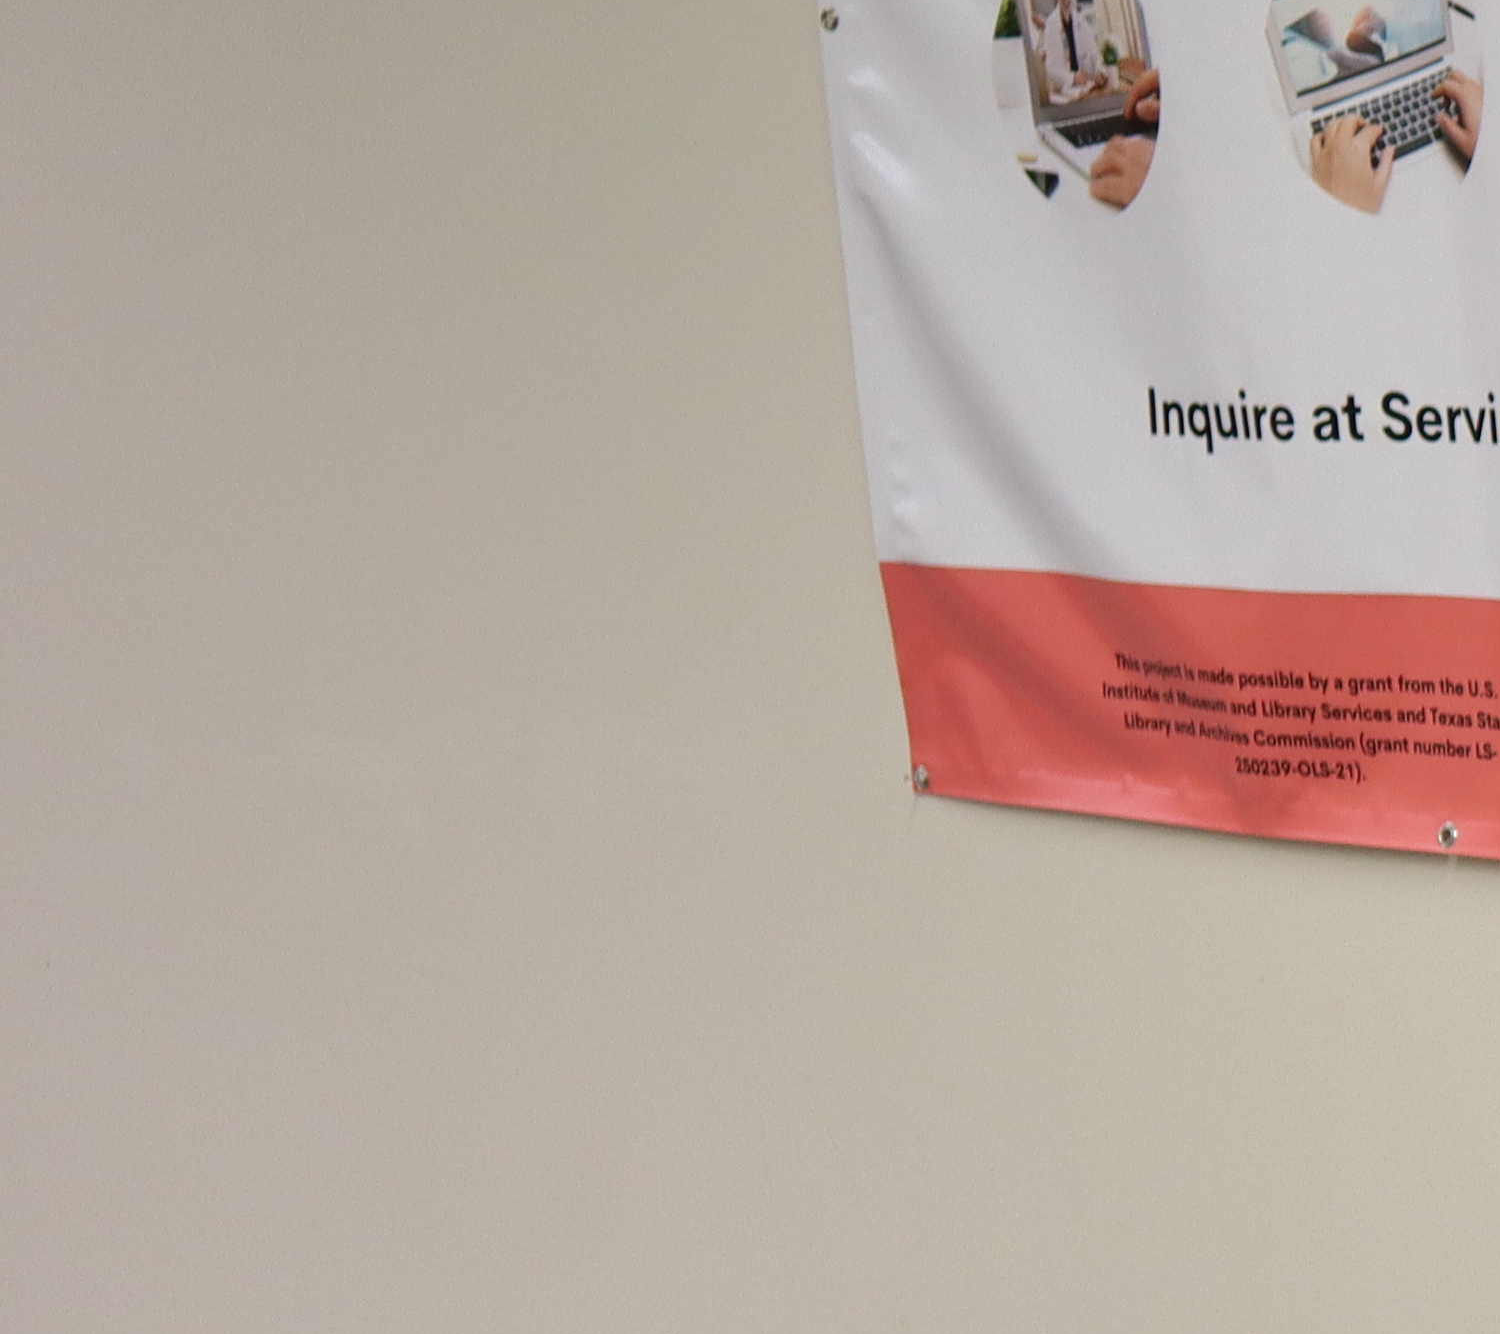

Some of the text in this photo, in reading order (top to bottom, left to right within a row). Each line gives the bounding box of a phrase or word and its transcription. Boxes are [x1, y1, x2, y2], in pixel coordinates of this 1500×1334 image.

[1147, 386, 1296, 455] Inquire
[1311, 394, 1365, 443] at
[1115, 653, 1140, 671] This
[1184, 664, 1195, 681] is
[1198, 668, 1234, 685] made
[1238, 671, 1304, 690] possible
[1308, 671, 1328, 694] by
[1334, 679, 1343, 691] a
[1348, 675, 1393, 696] grant
[1398, 675, 1435, 694] from
[1439, 677, 1464, 696] the
[1467, 679, 1499, 699] U.S.
[1102, 682, 1160, 703] Institute
[1163, 690, 1175, 705] of
[1176, 691, 1227, 713] Museum
[1230, 700, 1257, 716] and
[1261, 700, 1316, 723] Library
[1321, 702, 1392, 723] Services
[1397, 707, 1426, 724] and
[1429, 707, 1473, 728] Texas
[1124, 712, 1497, 761] Library and Archives Commission (grant number LS-
